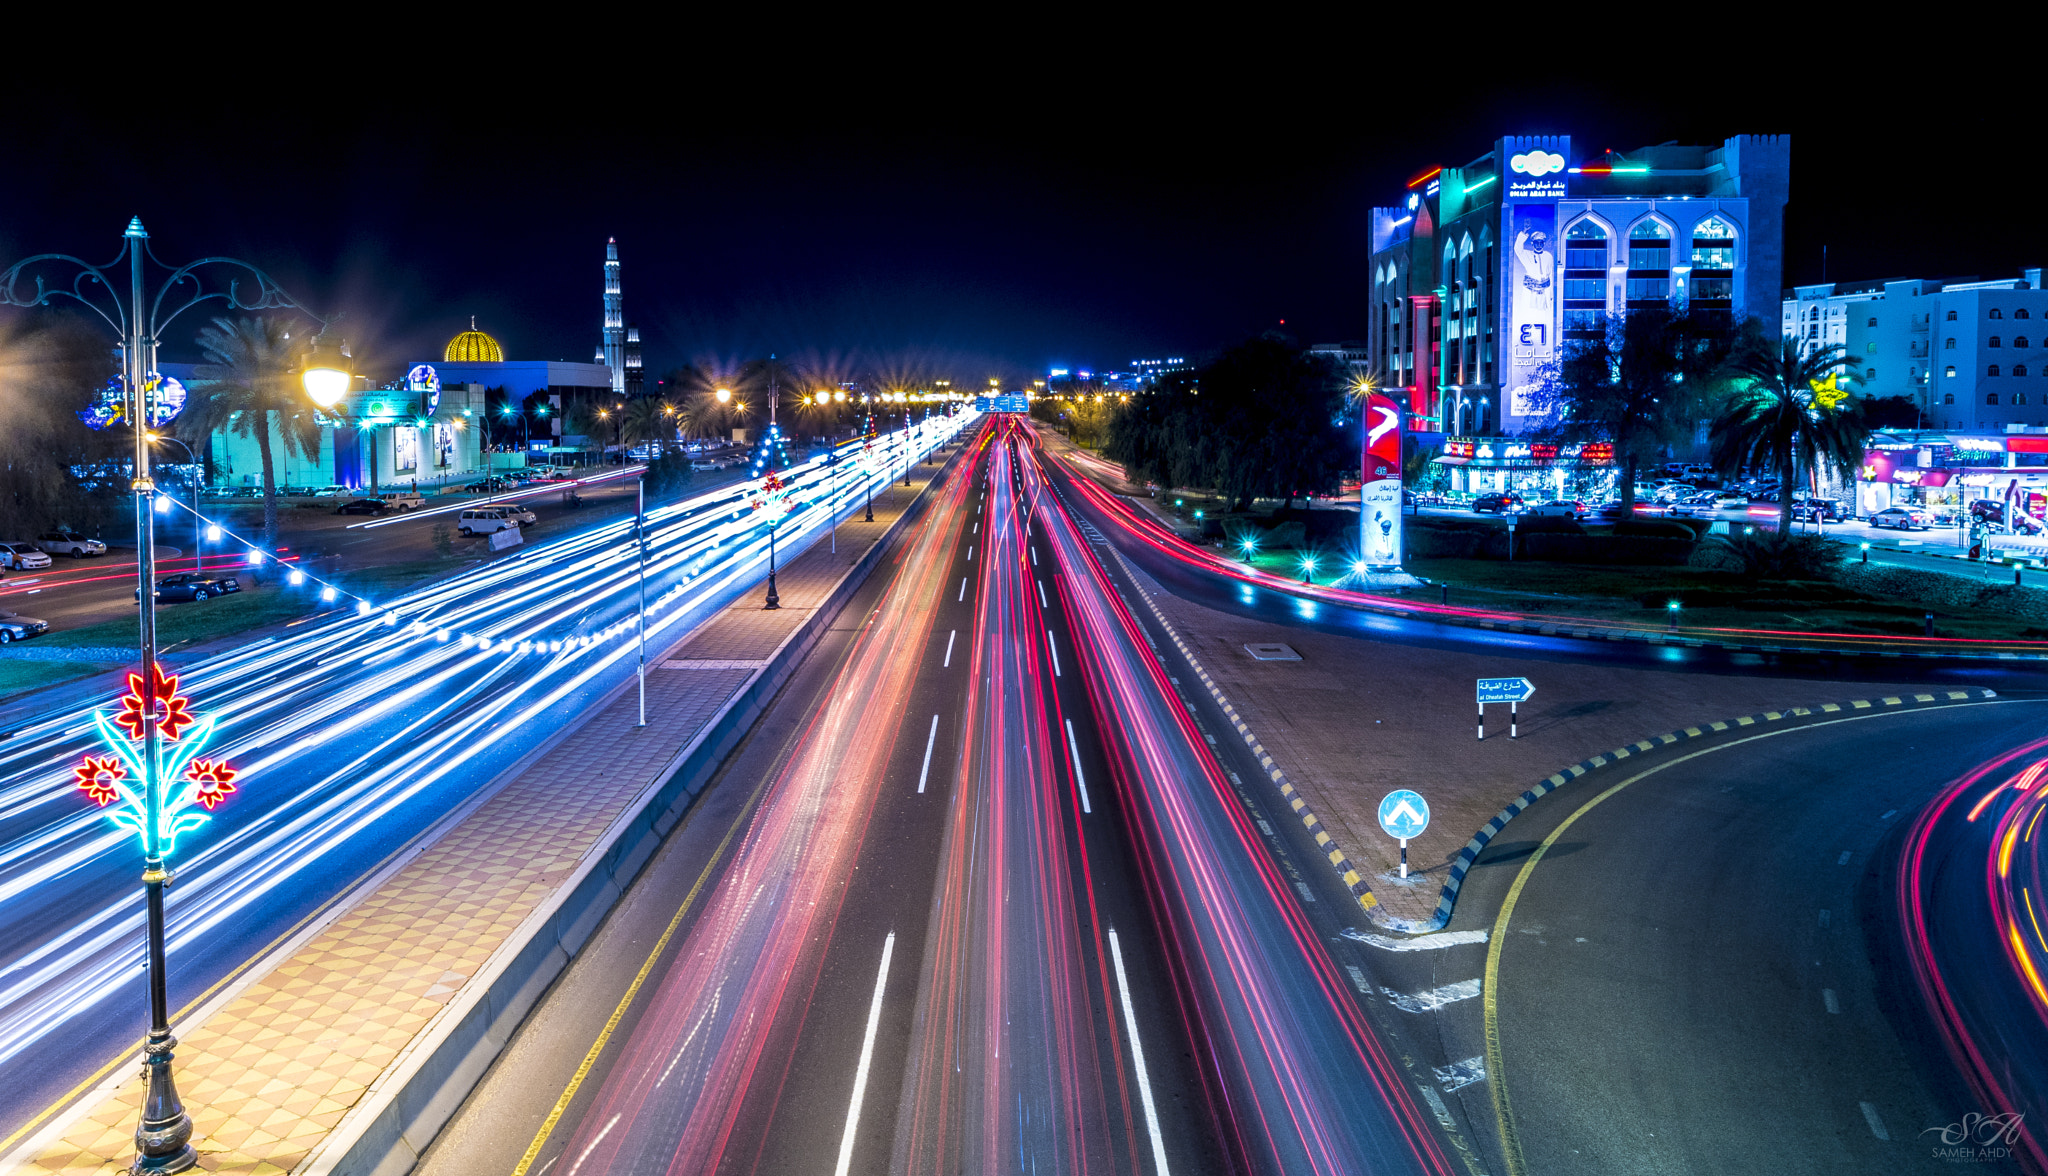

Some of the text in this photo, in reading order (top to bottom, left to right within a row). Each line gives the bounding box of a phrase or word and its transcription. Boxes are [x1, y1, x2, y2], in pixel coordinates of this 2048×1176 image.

[1510, 181, 1565, 190] بنك عمان العربي
[1375, 466, 1387, 475] 46
[1480, 681, 1520, 691] شارع الضيافة
